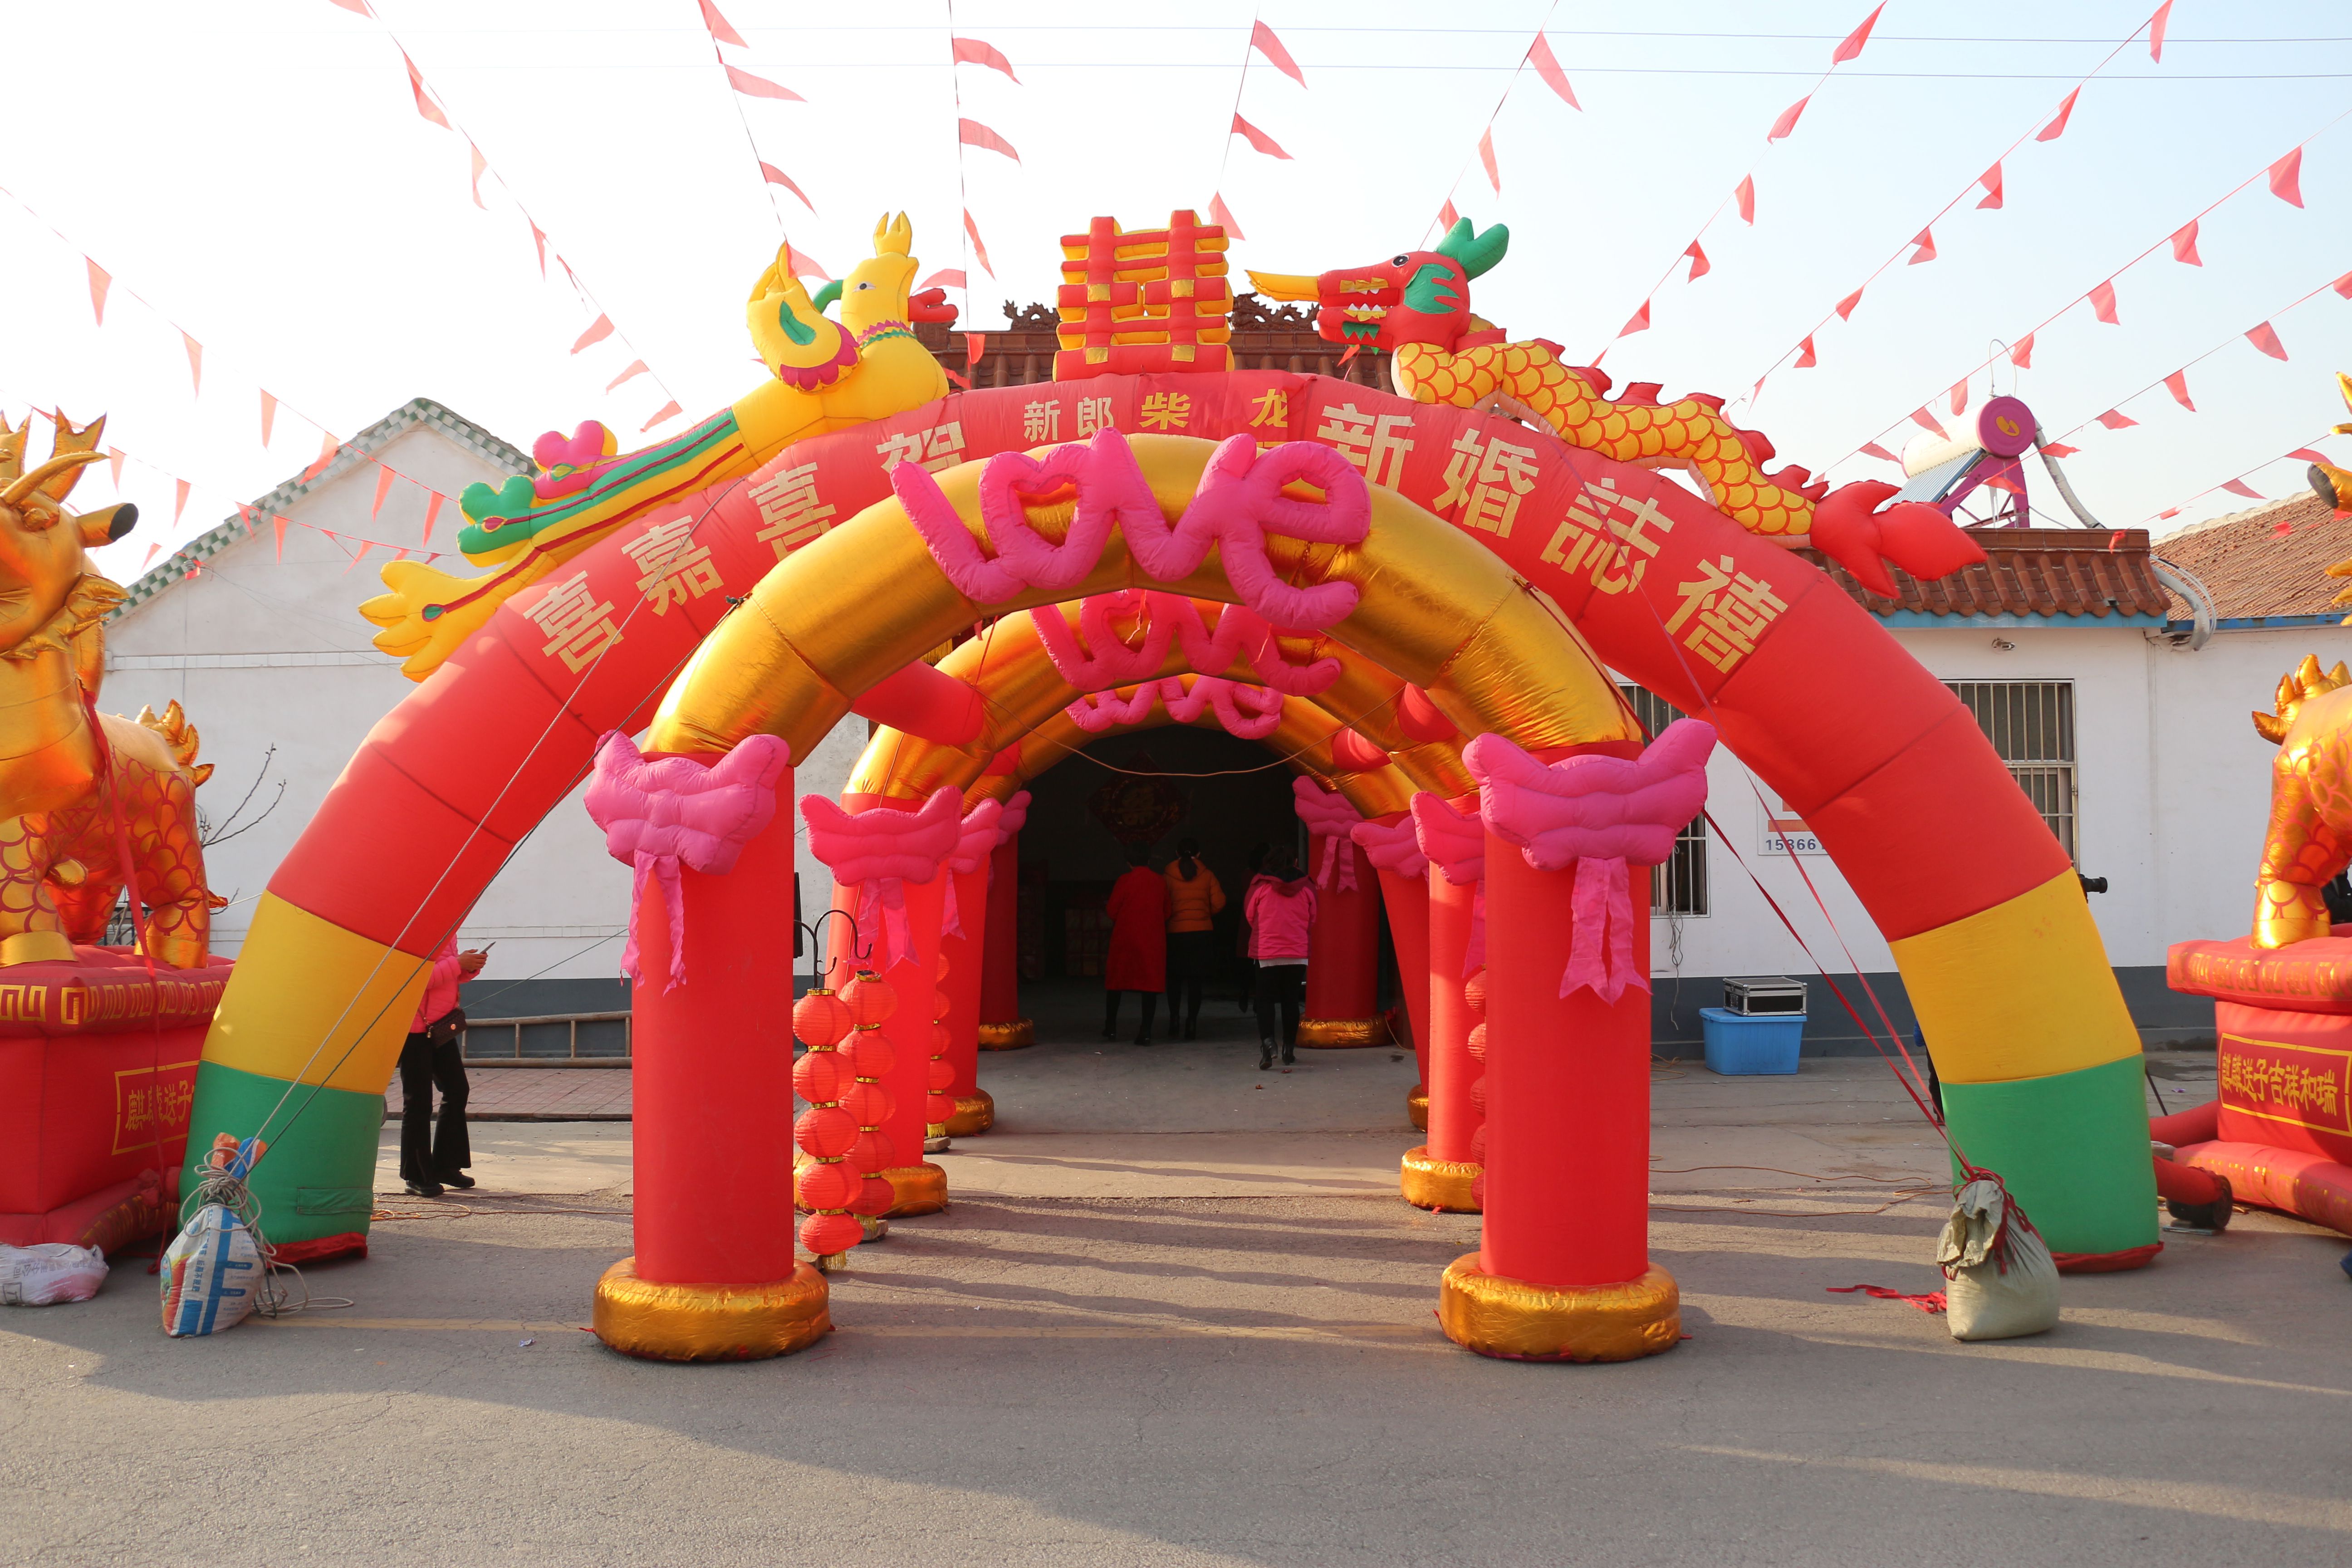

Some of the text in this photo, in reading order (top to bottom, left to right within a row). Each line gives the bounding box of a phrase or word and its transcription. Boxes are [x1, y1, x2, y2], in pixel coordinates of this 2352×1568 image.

[125, 1079, 195, 1131] 麒麟送子
[2221, 1051, 2338, 1116] 麒麟送子吉祥和瑞
